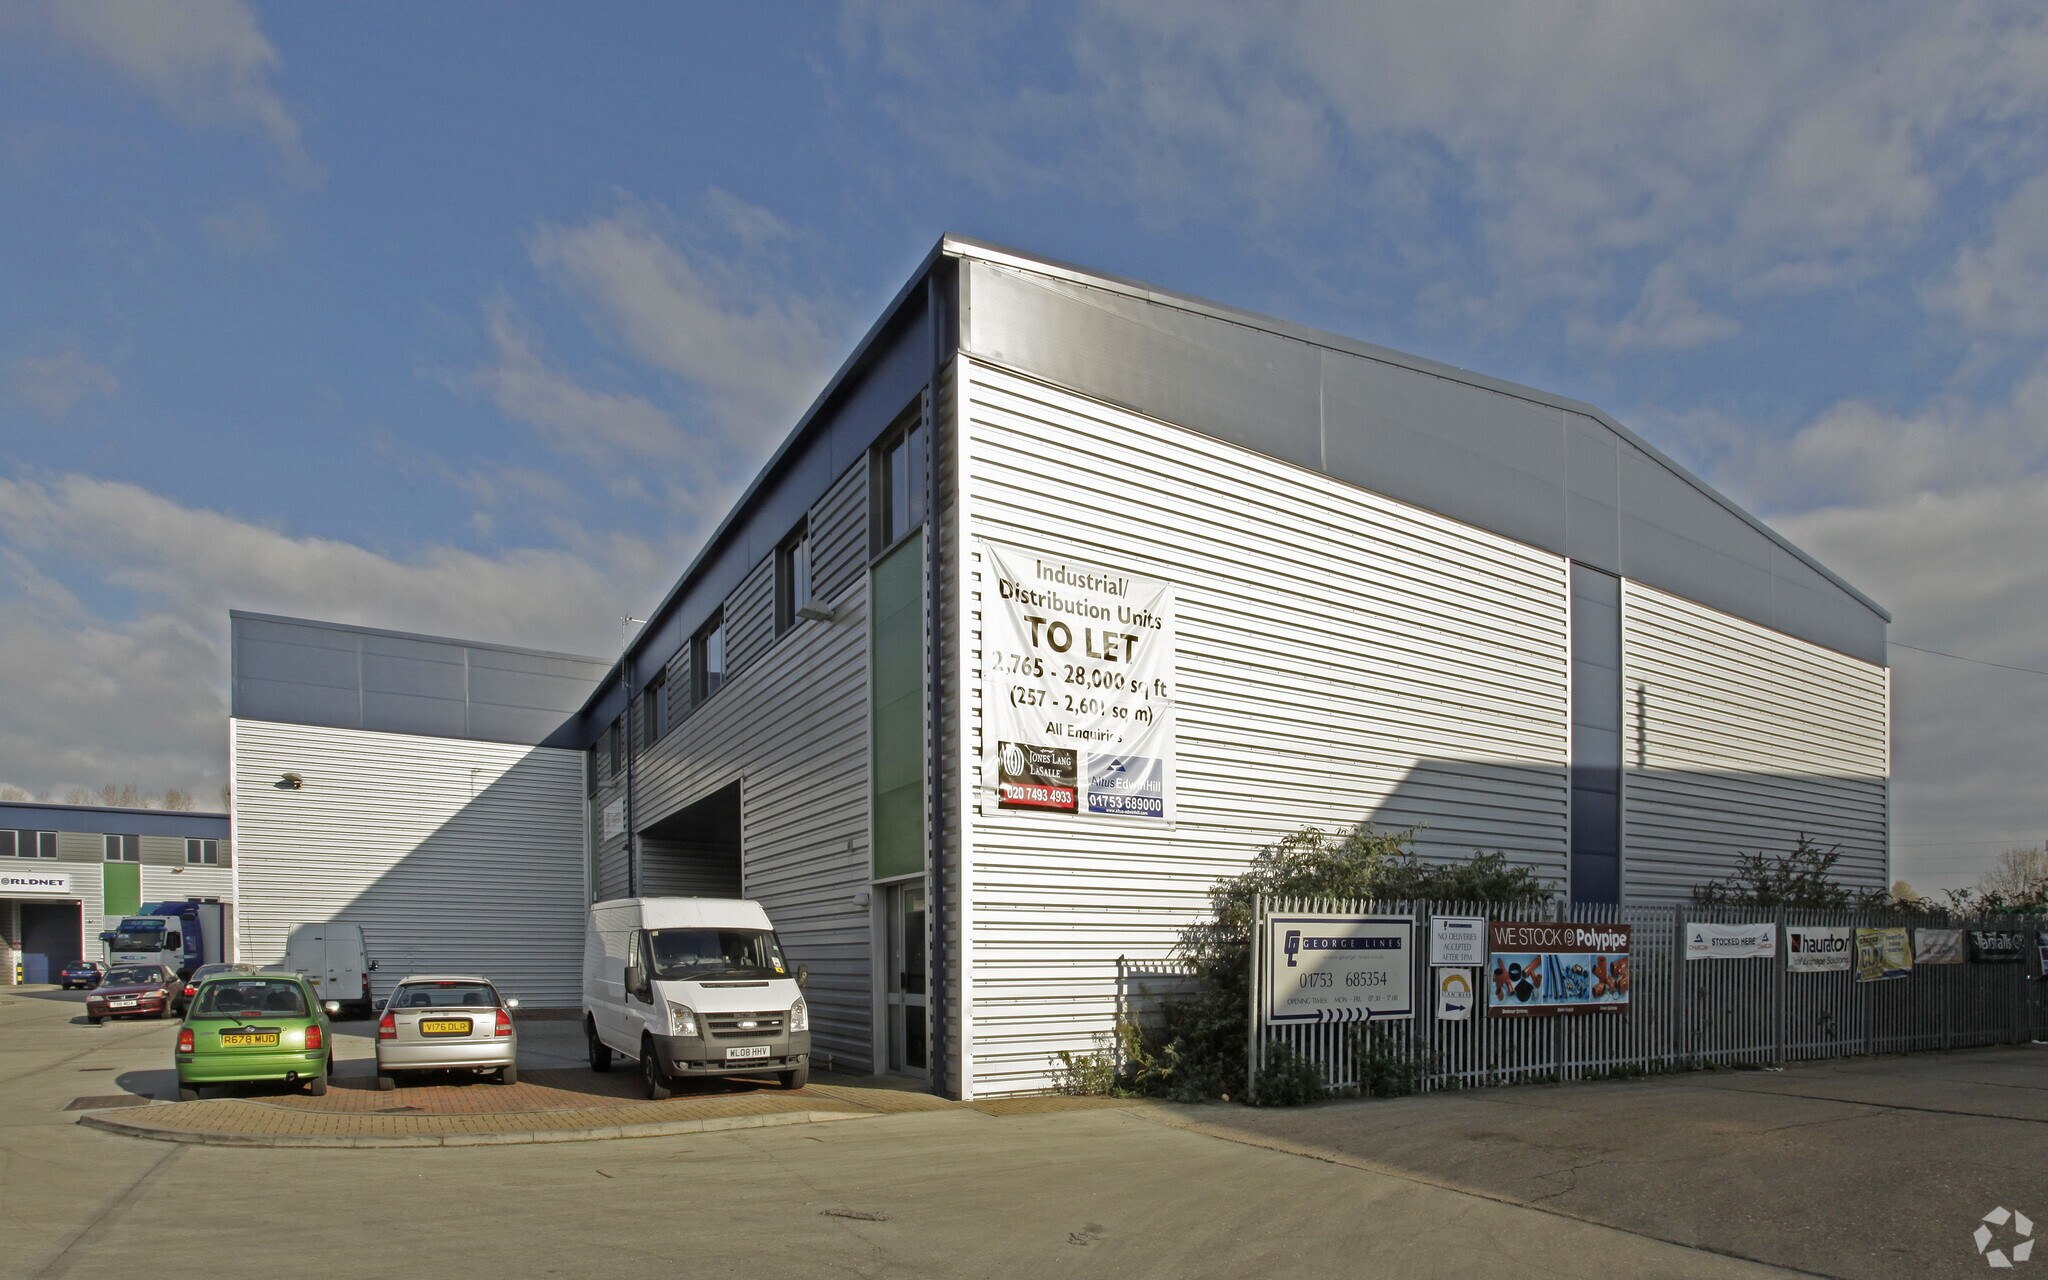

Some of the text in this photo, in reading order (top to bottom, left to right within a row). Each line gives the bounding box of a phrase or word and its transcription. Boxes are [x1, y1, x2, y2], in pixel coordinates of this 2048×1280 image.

[1036, 559, 1129, 599] Industrial/
[999, 578, 1162, 630] Distribution Units
[1024, 615, 1139, 664] TO LET
[992, 650, 1044, 678] 2,765
[1063, 664, 1125, 690] 28,000
[1153, 678, 1168, 698] ft
[1010, 685, 1046, 708] (257
[1135, 706, 1153, 727] m)
[1045, 721, 1063, 736] All
[1007, 786, 1072, 804] 020 7493 4933
[1089, 794, 1161, 812] 01753 689000
[1303, 938, 1401, 948] GEORGE LINES
[1448, 932, 1477, 940] DELIVERIES
[1494, 927, 1627, 951] WE STOCK Polypipe
[1711, 937, 1756, 946] STOCKED HERE
[1443, 943, 1472, 951] ACCEPTED
[1442, 953, 1459, 961] AFTER
[1299, 971, 1387, 988] 01753 685354
[1287, 997, 1311, 1005] OPENING
[426, 1023, 446, 1031] V176
[224, 1034, 276, 1044] R678 MUD
[752, 1047, 767, 1056] HHV
